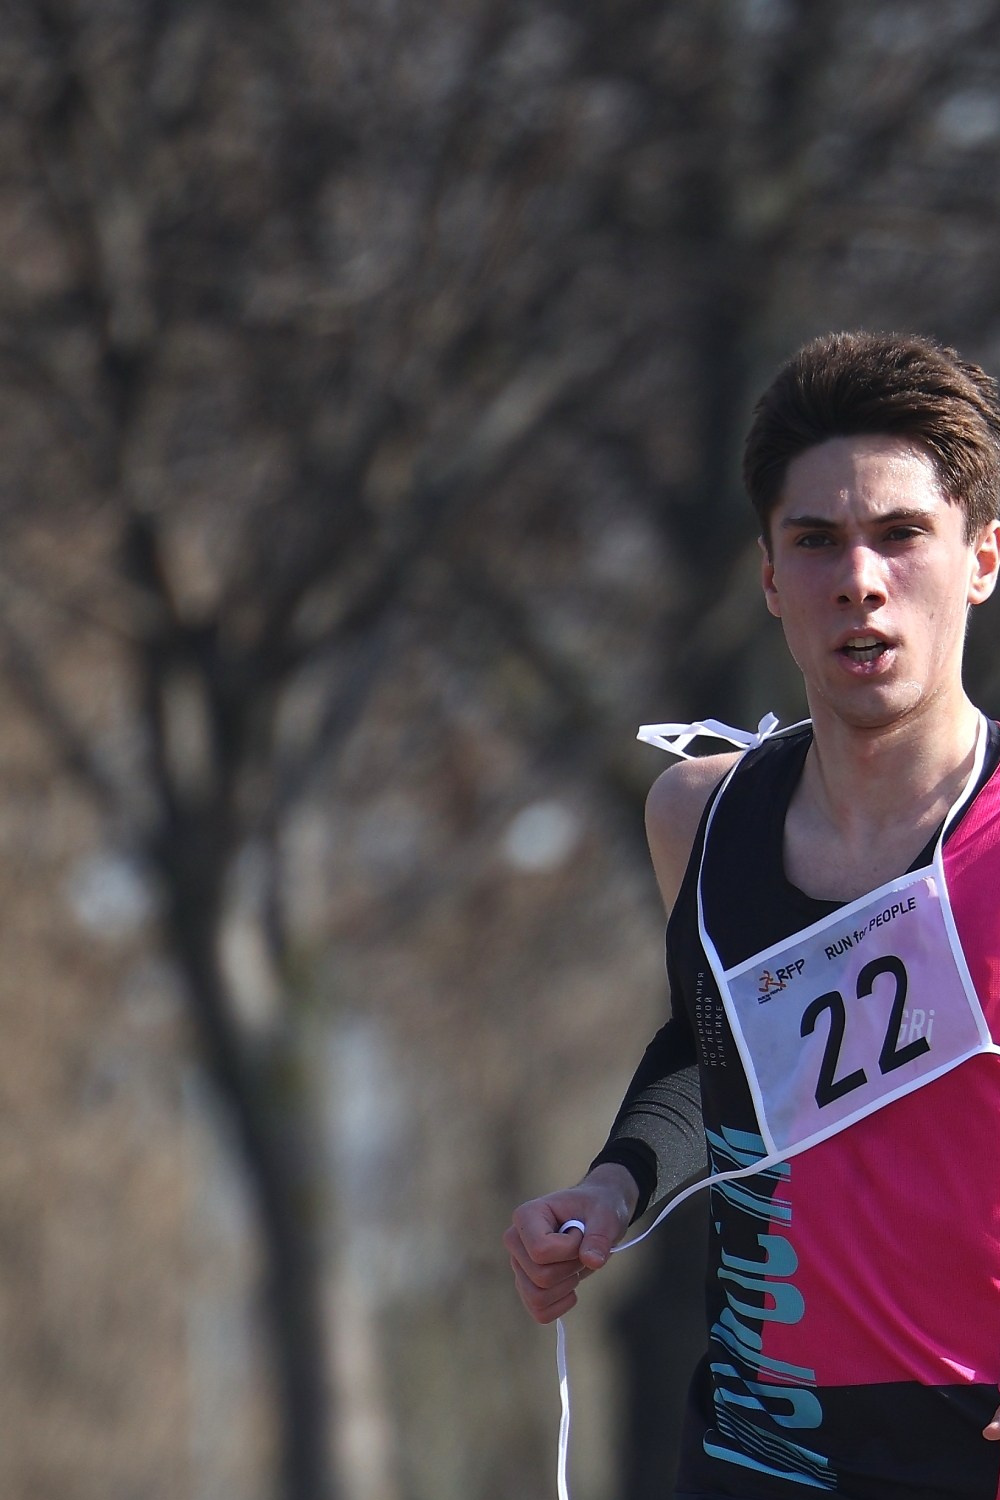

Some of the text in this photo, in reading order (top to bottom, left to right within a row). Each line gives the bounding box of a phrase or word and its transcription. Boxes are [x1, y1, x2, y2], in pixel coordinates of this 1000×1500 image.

[824, 897, 916, 961] RUN for PEOPLE
[775, 958, 805, 983] RFP
[800, 954, 930, 1109] 22
